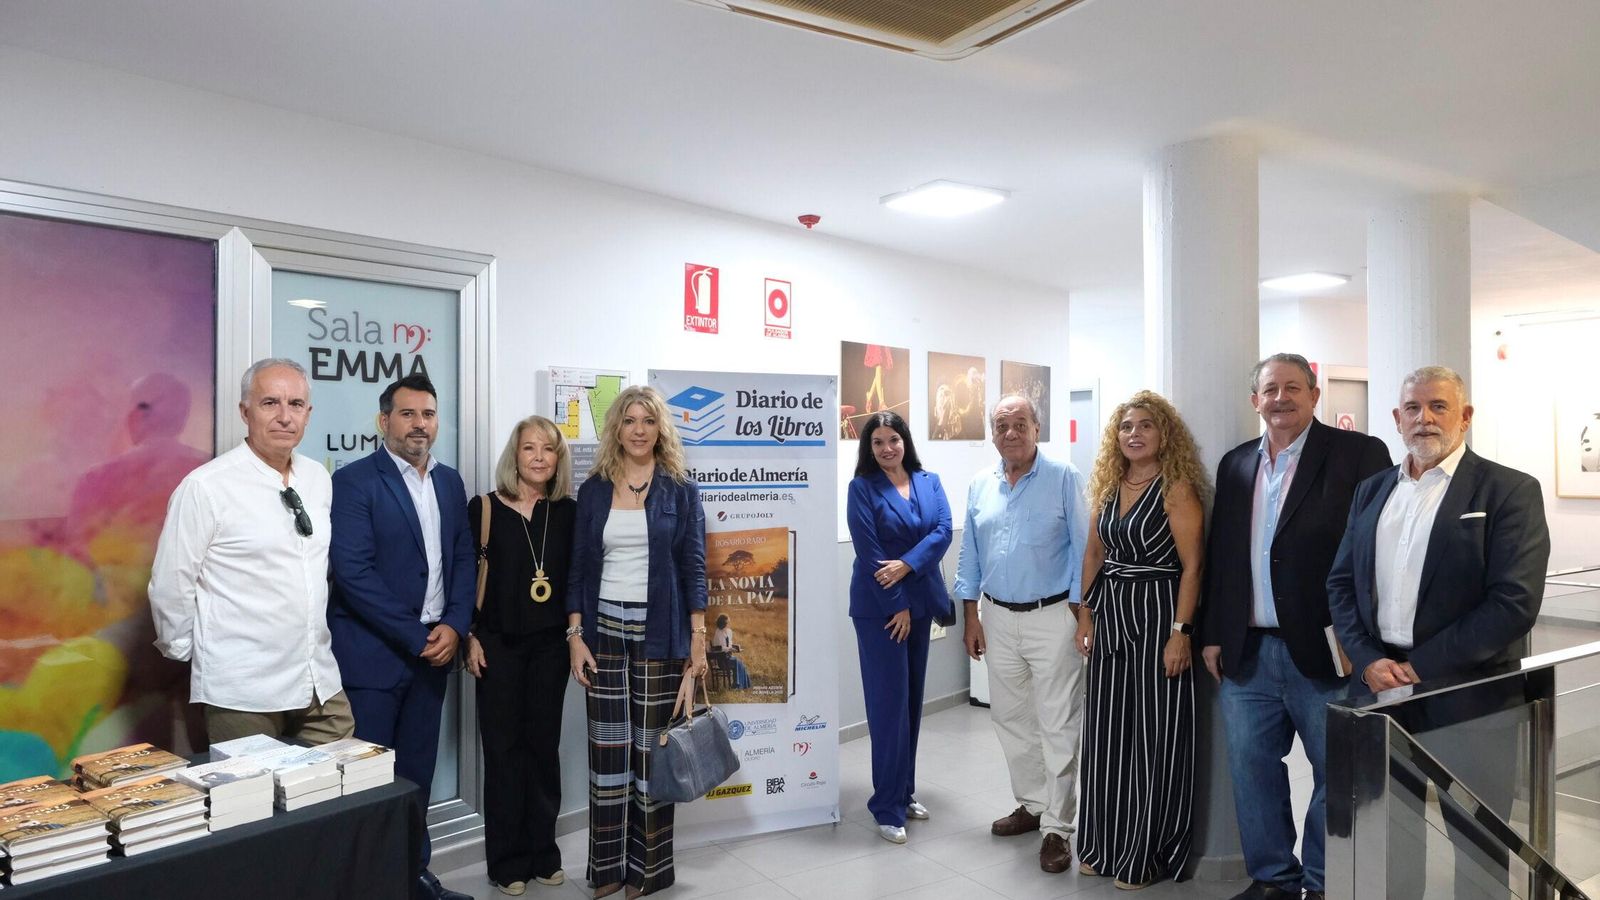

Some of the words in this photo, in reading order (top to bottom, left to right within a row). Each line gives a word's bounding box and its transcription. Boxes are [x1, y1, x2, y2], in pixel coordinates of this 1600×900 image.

[308, 307, 384, 345] Sala
[686, 315, 717, 328] EXTINTOR
[309, 347, 431, 383] EMMA
[735, 390, 798, 409] Diario
[802, 392, 823, 409] de
[735, 415, 763, 436] los
[768, 415, 824, 442] Libros
[327, 434, 384, 451] LUM
[730, 468, 747, 482] de
[749, 467, 808, 482] Almería
[715, 539, 746, 547] ROSARIO
[747, 537, 766, 545] RARO
[708, 578, 725, 591] LA
[729, 575, 774, 589] NOVIA
[708, 595, 724, 606] DE
[727, 595, 743, 605] LA
[747, 591, 774, 604] PAZ
[795, 724, 826, 732] MICHELIN
[744, 745, 775, 756] ALMERÍA
[766, 777, 785, 787] BIBA
